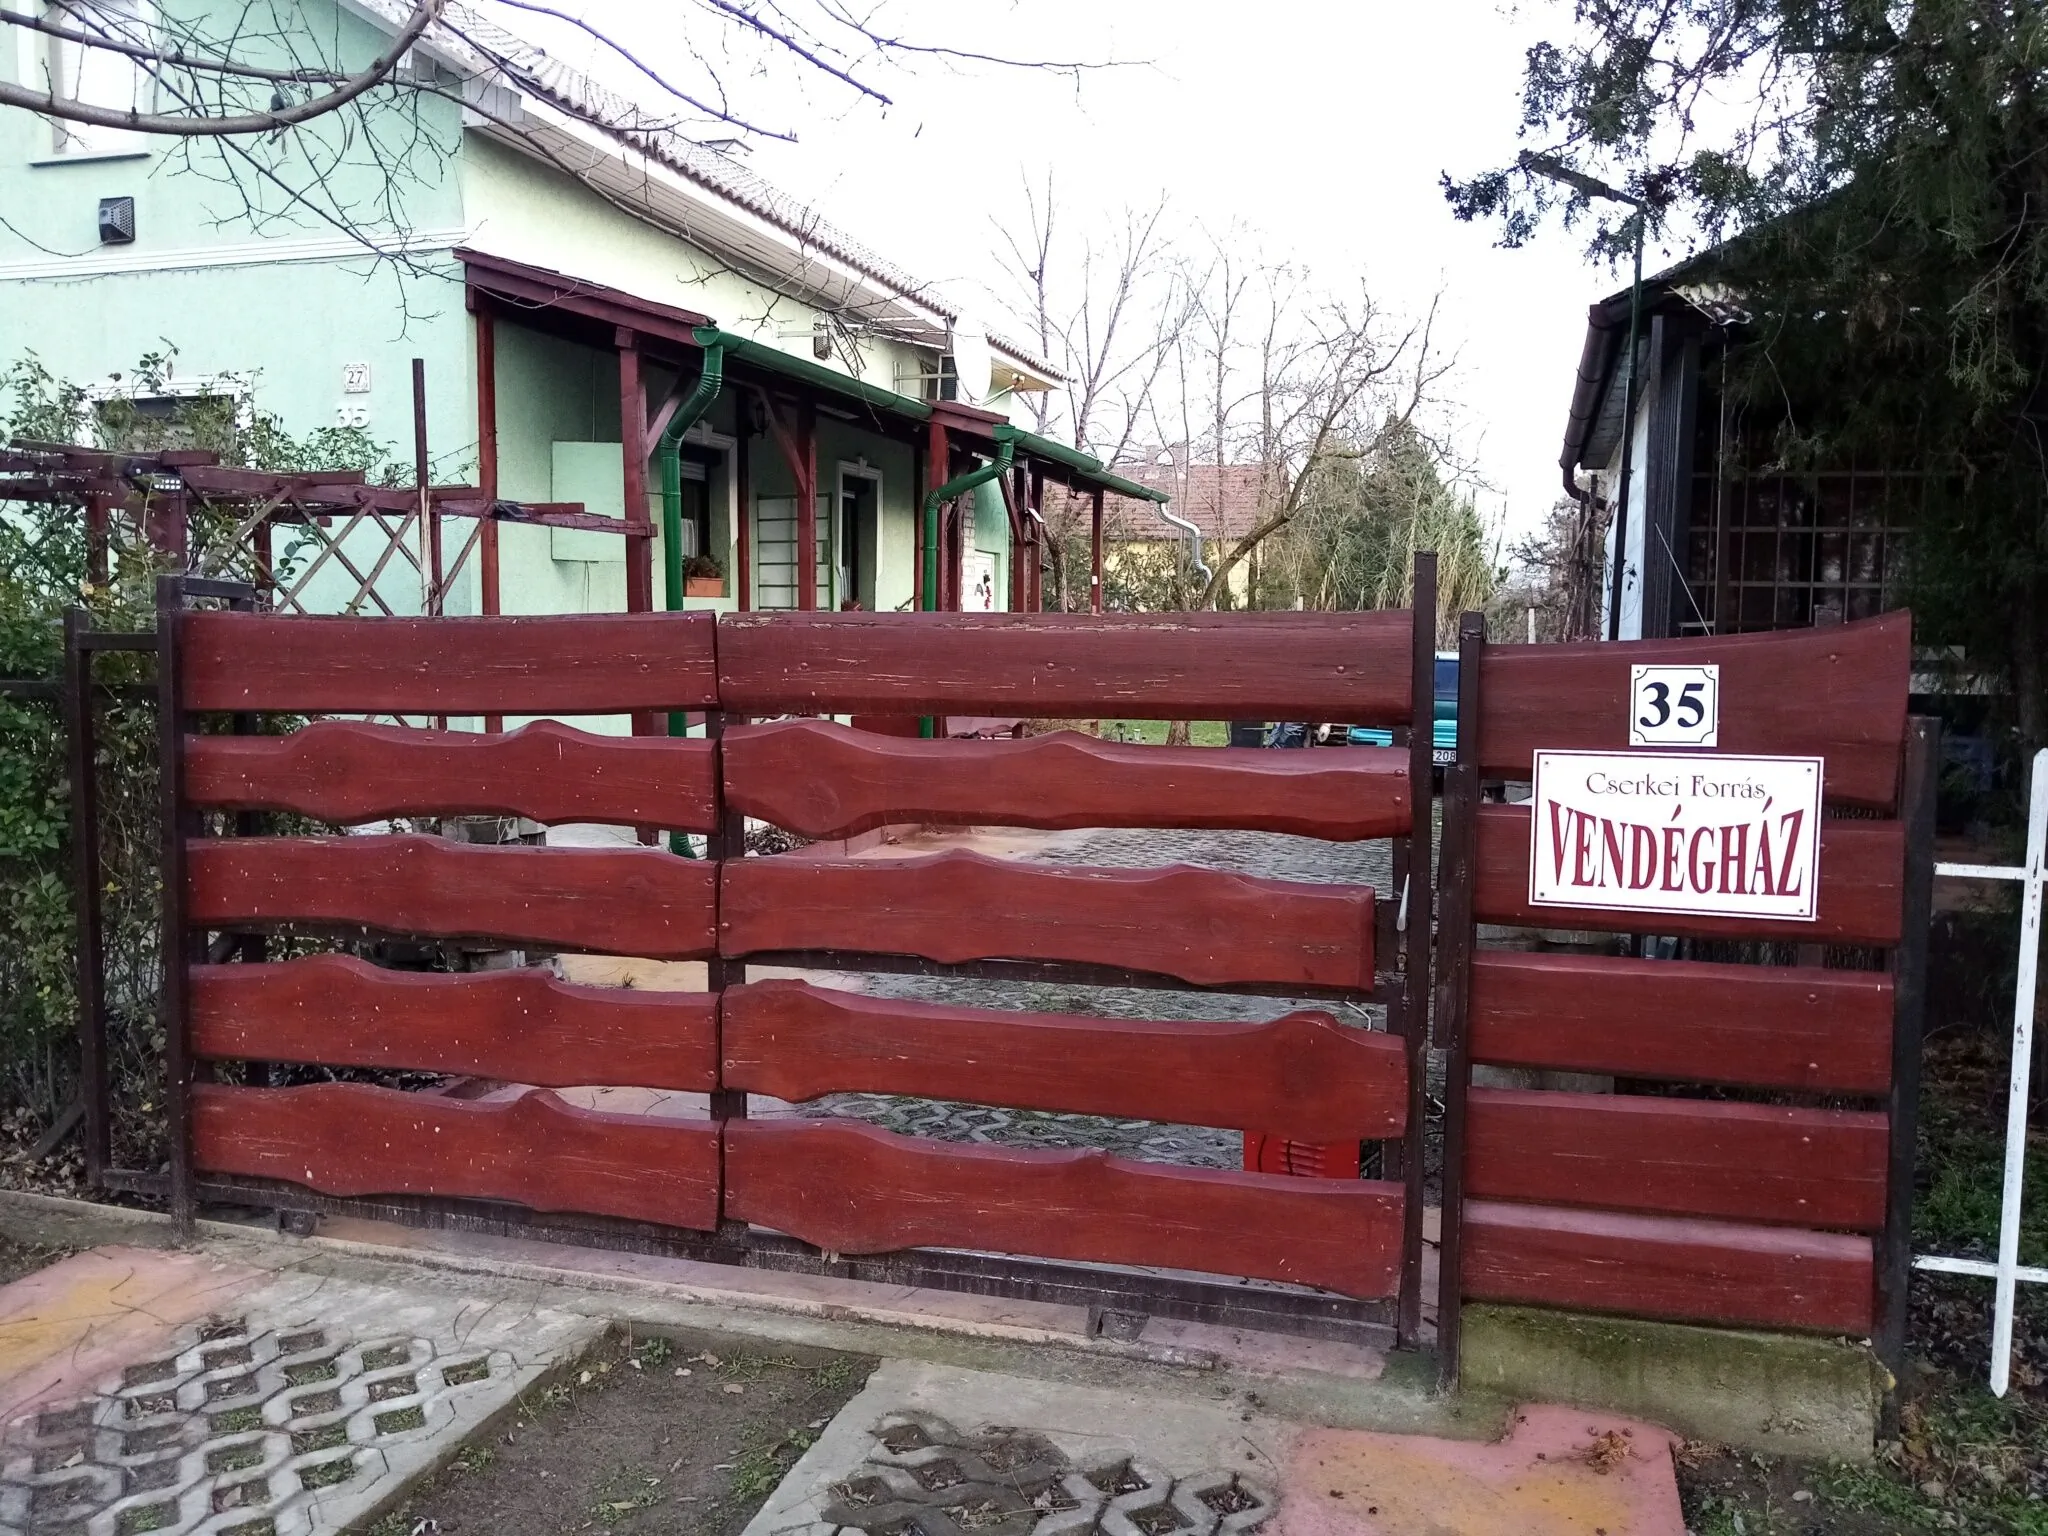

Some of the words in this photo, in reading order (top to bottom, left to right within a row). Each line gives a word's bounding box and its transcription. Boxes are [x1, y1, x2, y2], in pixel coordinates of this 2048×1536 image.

[348, 370, 363, 384] 27
[336, 402, 371, 429] 35
[1639, 681, 1706, 728] 35
[1586, 772, 1680, 797] Cserkei
[1691, 774, 1767, 800] Forrás
[1548, 796, 1804, 897] VENDÉGHÁZ
